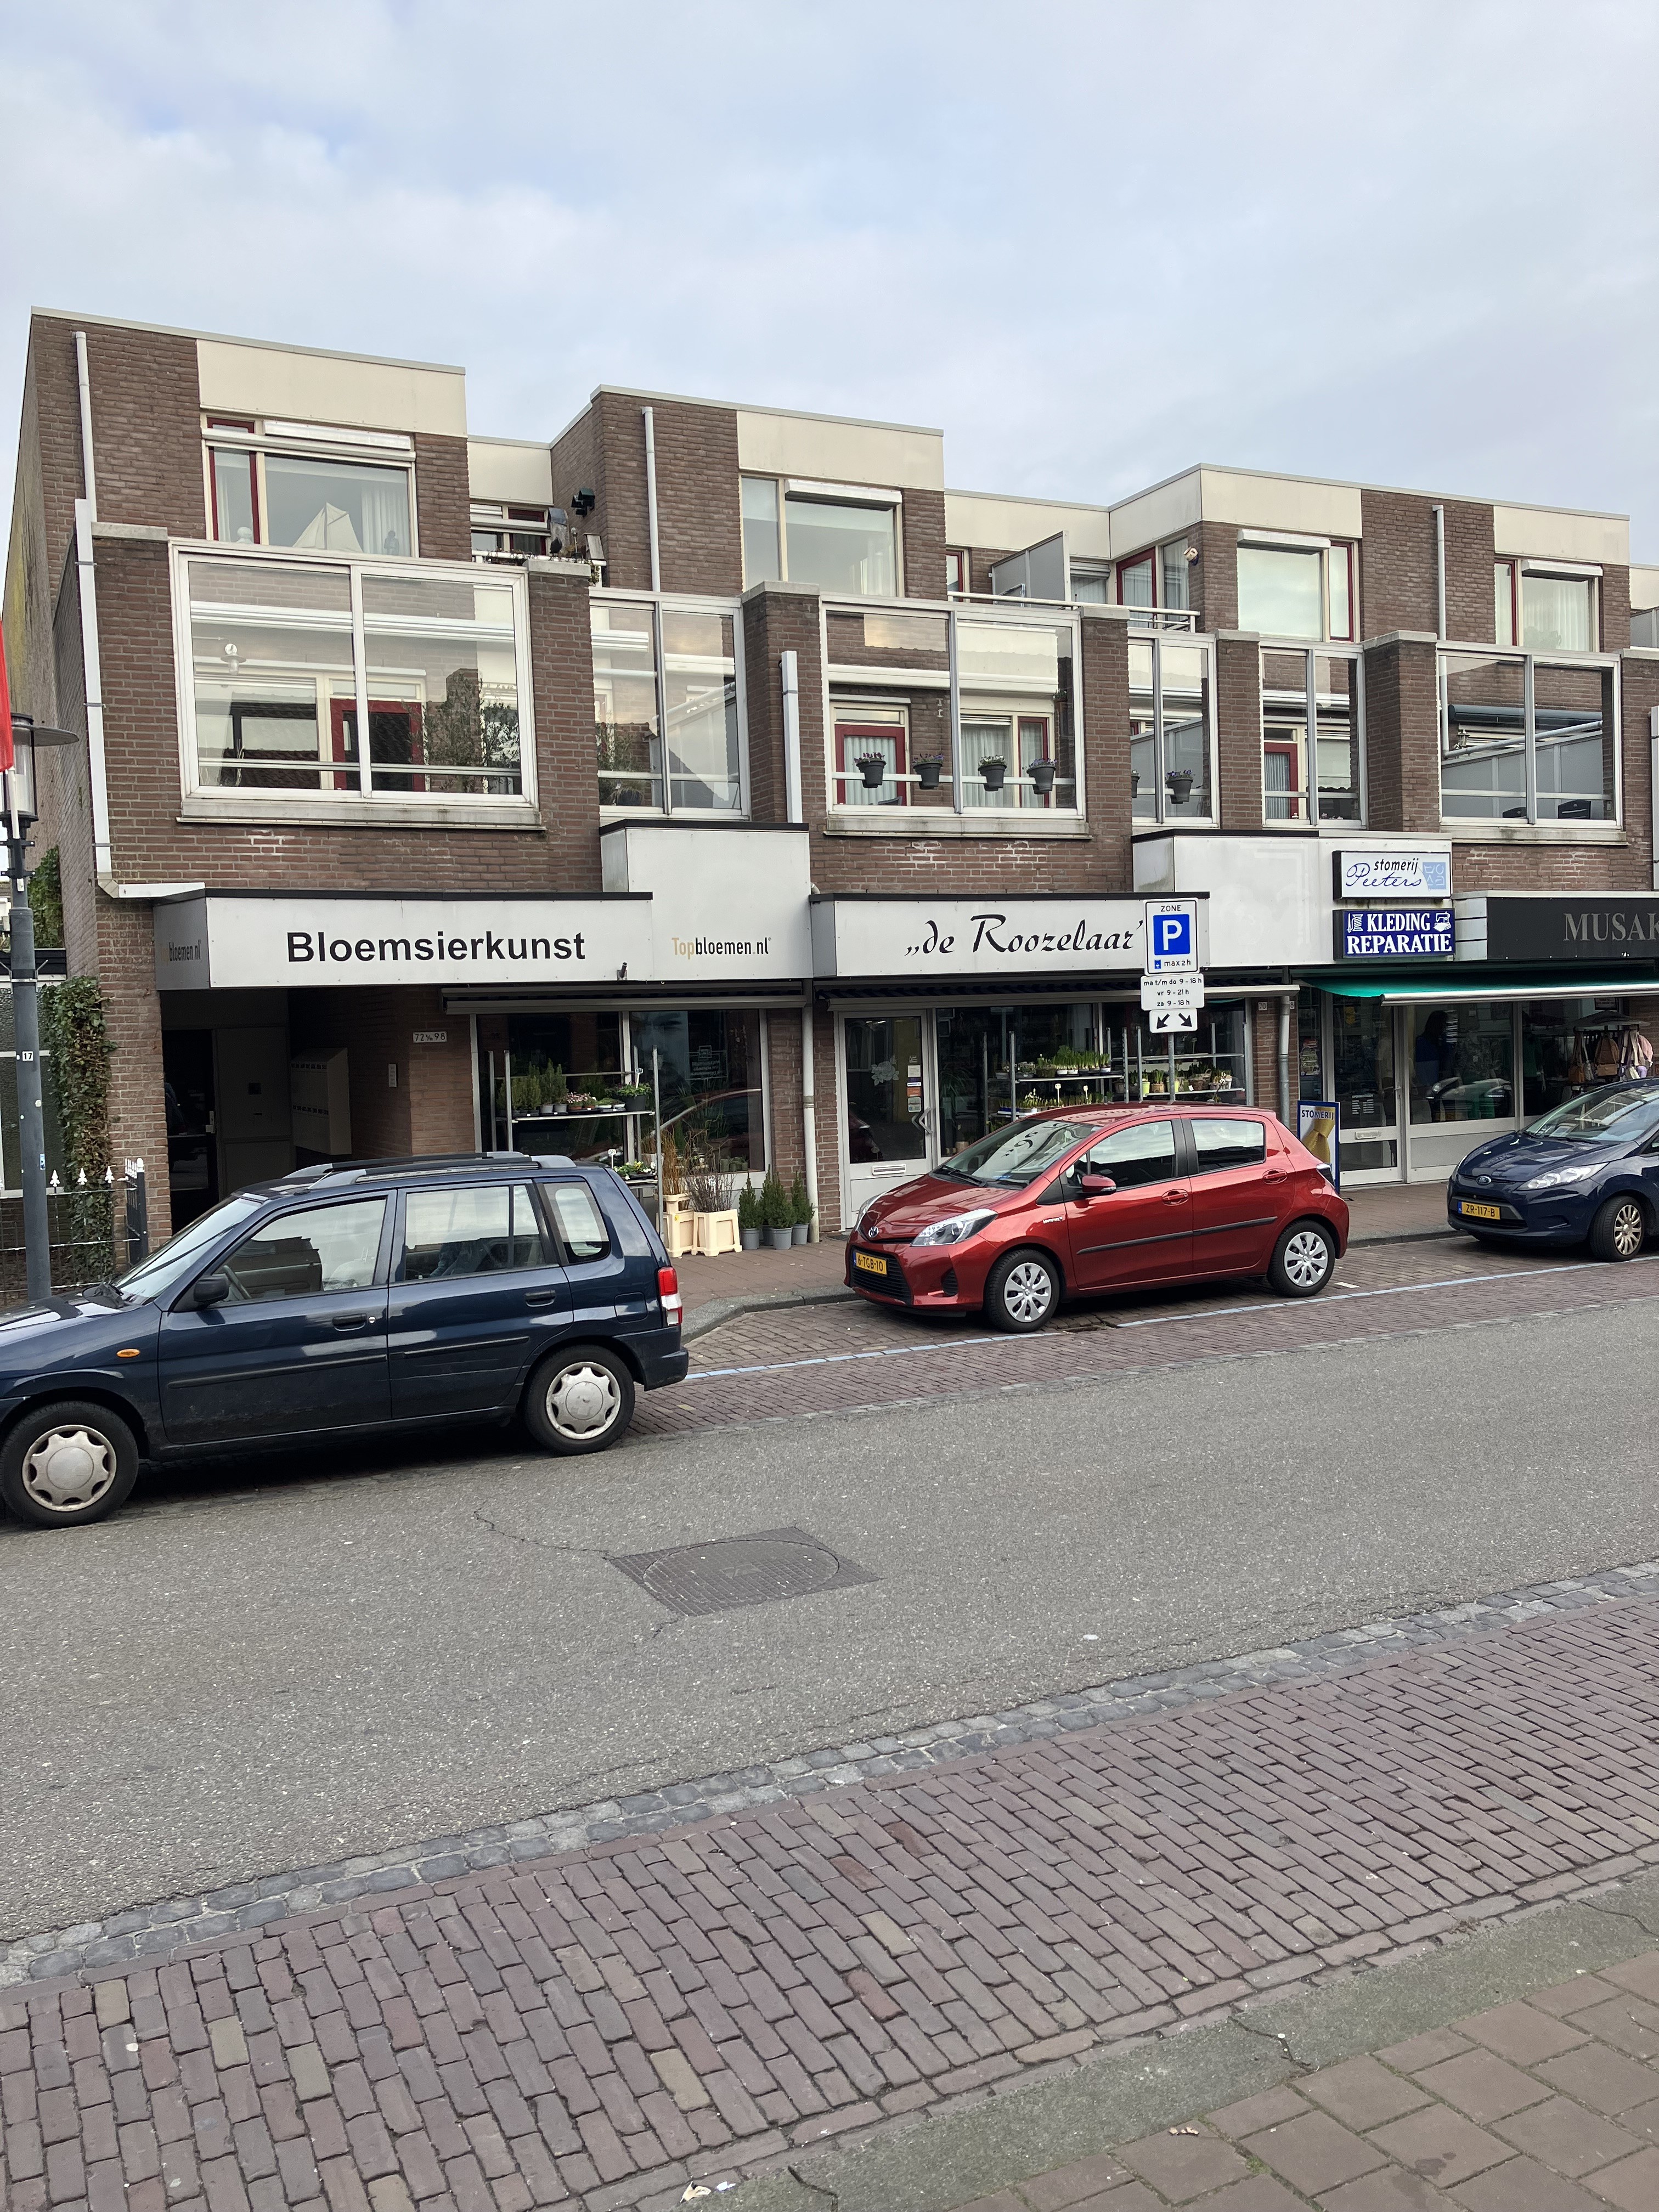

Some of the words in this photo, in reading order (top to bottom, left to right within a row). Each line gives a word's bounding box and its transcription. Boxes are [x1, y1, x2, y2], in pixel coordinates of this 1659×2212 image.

[1346, 862, 1422, 887] Peeters
[1374, 857, 1419, 874] stomerij
[1367, 913, 1431, 932] KLEDING
[1562, 912, 1659, 941] MUSAK
[1163, 919, 1182, 951] P
[1347, 934, 1452, 954] REPARATIE
[287, 930, 586, 962] Bloemsierkunst
[414, 1033, 425, 1041] 72
[434, 1032, 445, 1041] 98
[1301, 1109, 1334, 1120] STOMERIJ
[1466, 1204, 1495, 1217] ZR-117-B
